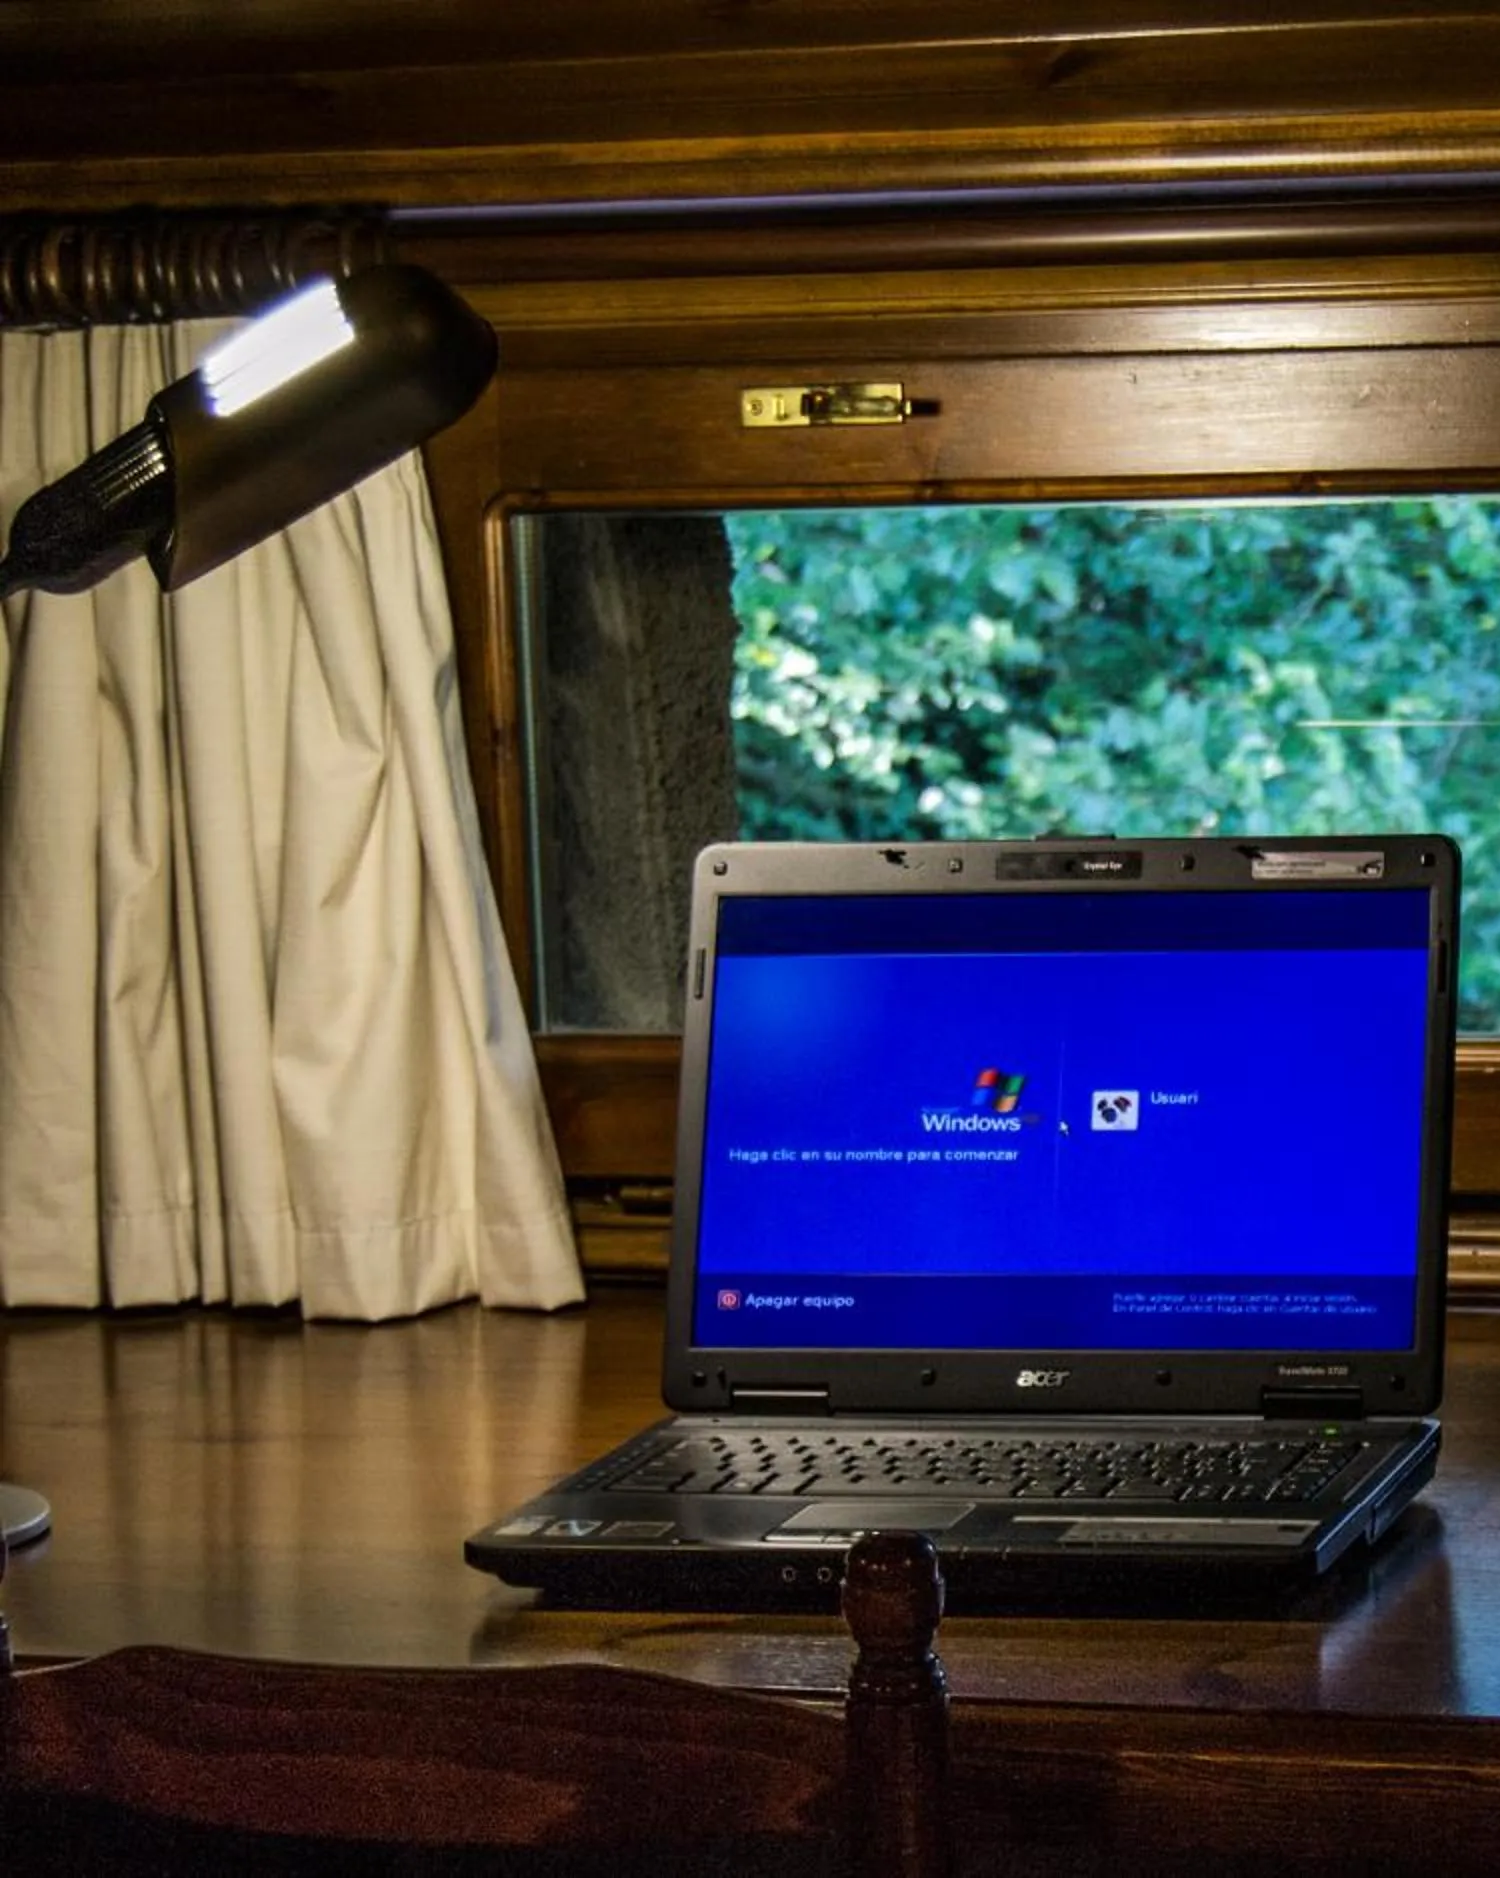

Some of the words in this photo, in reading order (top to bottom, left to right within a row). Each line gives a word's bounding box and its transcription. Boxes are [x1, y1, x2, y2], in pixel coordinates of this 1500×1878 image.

[922, 1113, 1021, 1132] Windows
[729, 1149, 768, 1164] Haga
[772, 1149, 796, 1161] clic
[801, 1151, 820, 1161] en
[824, 1151, 842, 1161] su
[845, 1149, 903, 1161] nombre
[907, 1151, 941, 1164] para
[945, 1151, 1018, 1161] comenzar
[745, 1293, 799, 1310] Apagar
[803, 1294, 855, 1310] equipo
[1016, 1370, 1070, 1387] acer
